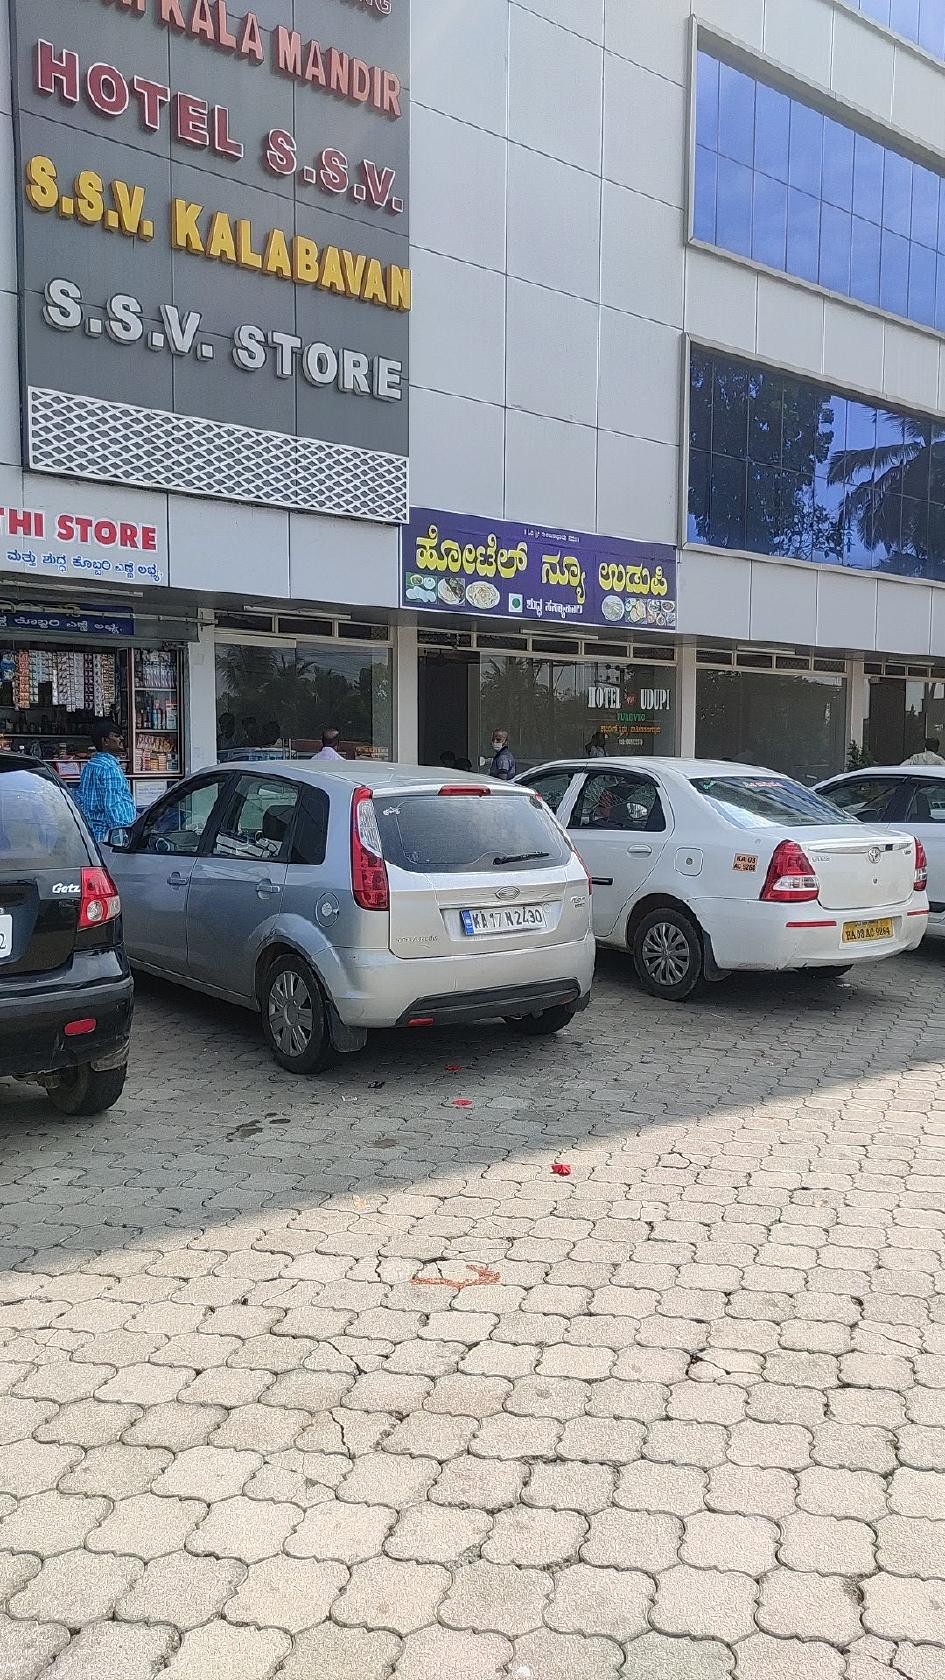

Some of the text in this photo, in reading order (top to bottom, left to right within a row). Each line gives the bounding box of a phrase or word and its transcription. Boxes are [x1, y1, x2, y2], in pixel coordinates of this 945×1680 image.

[157, 0, 401, 117] KALA MANDIR
[36, 38, 403, 213] HOTEL S.S.V.
[26, 155, 411, 311] S.S.V. KALABAVAN
[43, 277, 402, 402] S.S.V. STORE
[0, 507, 157, 550] HI STORE
[7, 549, 36, 567] ಮತ್ತು
[416, 524, 528, 579] ಹೋಟೆಲ್
[598, 561, 668, 597] ಉಡುಪಿ
[588, 686, 622, 709] HOTEL
[640, 688, 670, 710] UDUPI
[52, 882, 81, 893] Getz
